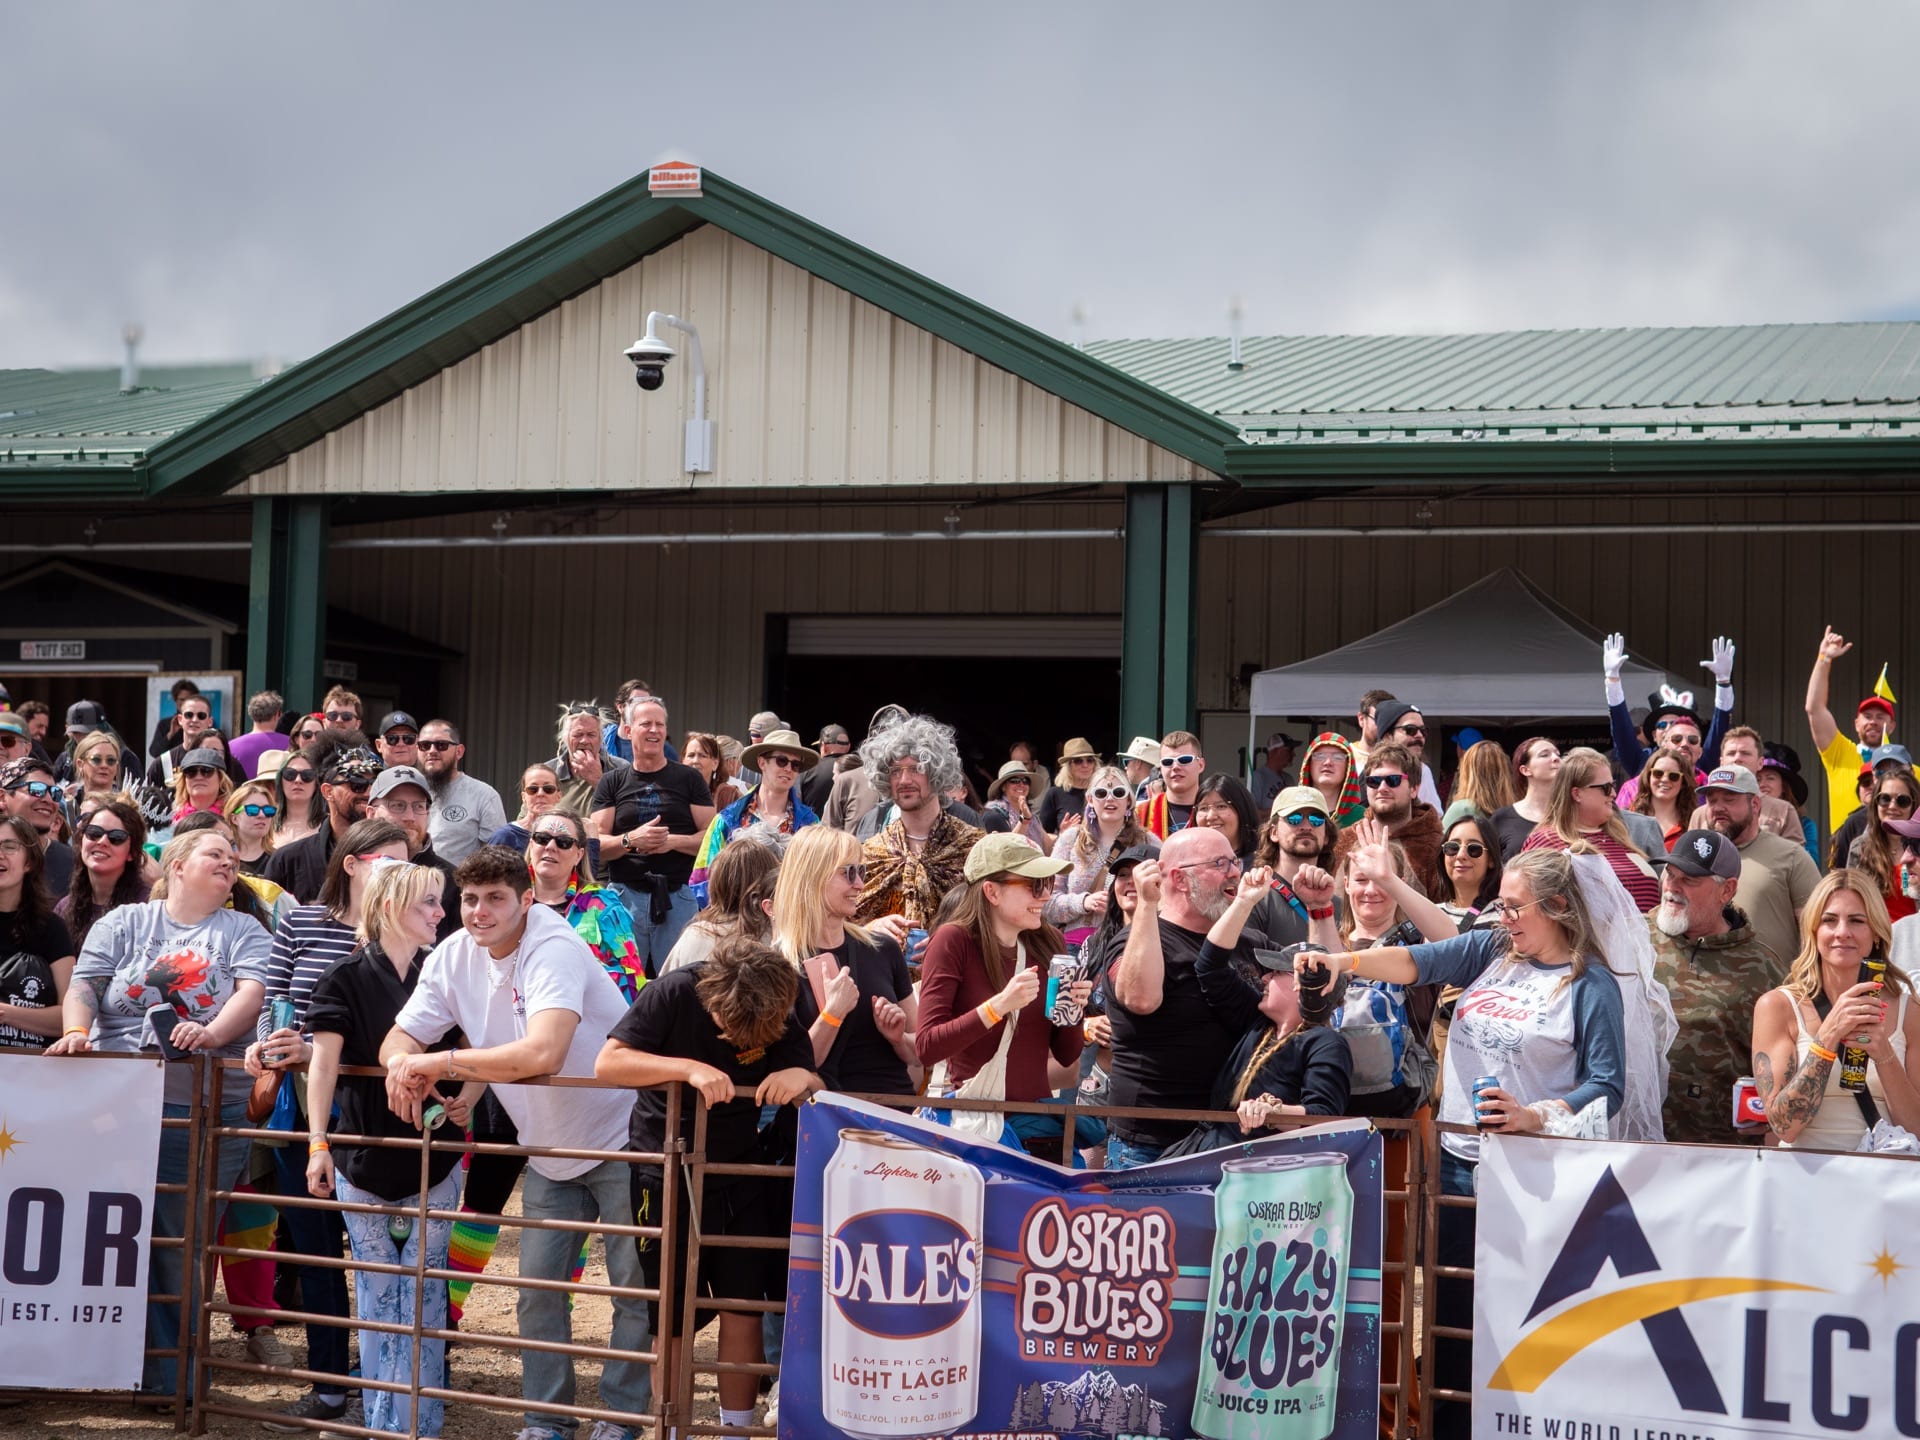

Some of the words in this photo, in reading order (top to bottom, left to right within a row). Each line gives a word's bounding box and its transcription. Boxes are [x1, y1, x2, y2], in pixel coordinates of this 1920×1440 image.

[1457, 989, 1536, 1022] Texas
[864, 1162, 919, 1181] Lighten
[923, 1168, 942, 1185] Up
[1247, 1201, 1285, 1222] OSKAR
[1288, 1201, 1323, 1222] BLUES
[3, 1187, 143, 1288] OR
[1026, 1204, 1170, 1279] OSKAR
[828, 1237, 976, 1304] DALE'S
[12, 1302, 59, 1322] EST.
[73, 1305, 123, 1323] 1972
[1022, 1272, 1164, 1340] BLUES
[852, 1356, 950, 1367] AMERICAN
[1025, 1339, 1157, 1360] BREWERY
[1210, 1312, 1337, 1390] BLUES
[833, 1363, 893, 1390] LIGHT
[901, 1365, 968, 1390] LAGER
[860, 1392, 881, 1401] 95
[892, 1392, 940, 1402] CALS
[1217, 1393, 1269, 1415] JUICY
[1273, 1398, 1302, 1415] IPA
[900, 1414, 908, 1424] 12
[910, 1414, 922, 1424] FL.
[923, 1413, 937, 1423] OZ.
[1495, 1412, 1532, 1435] THE
[1543, 1417, 1620, 1440] WORLD
